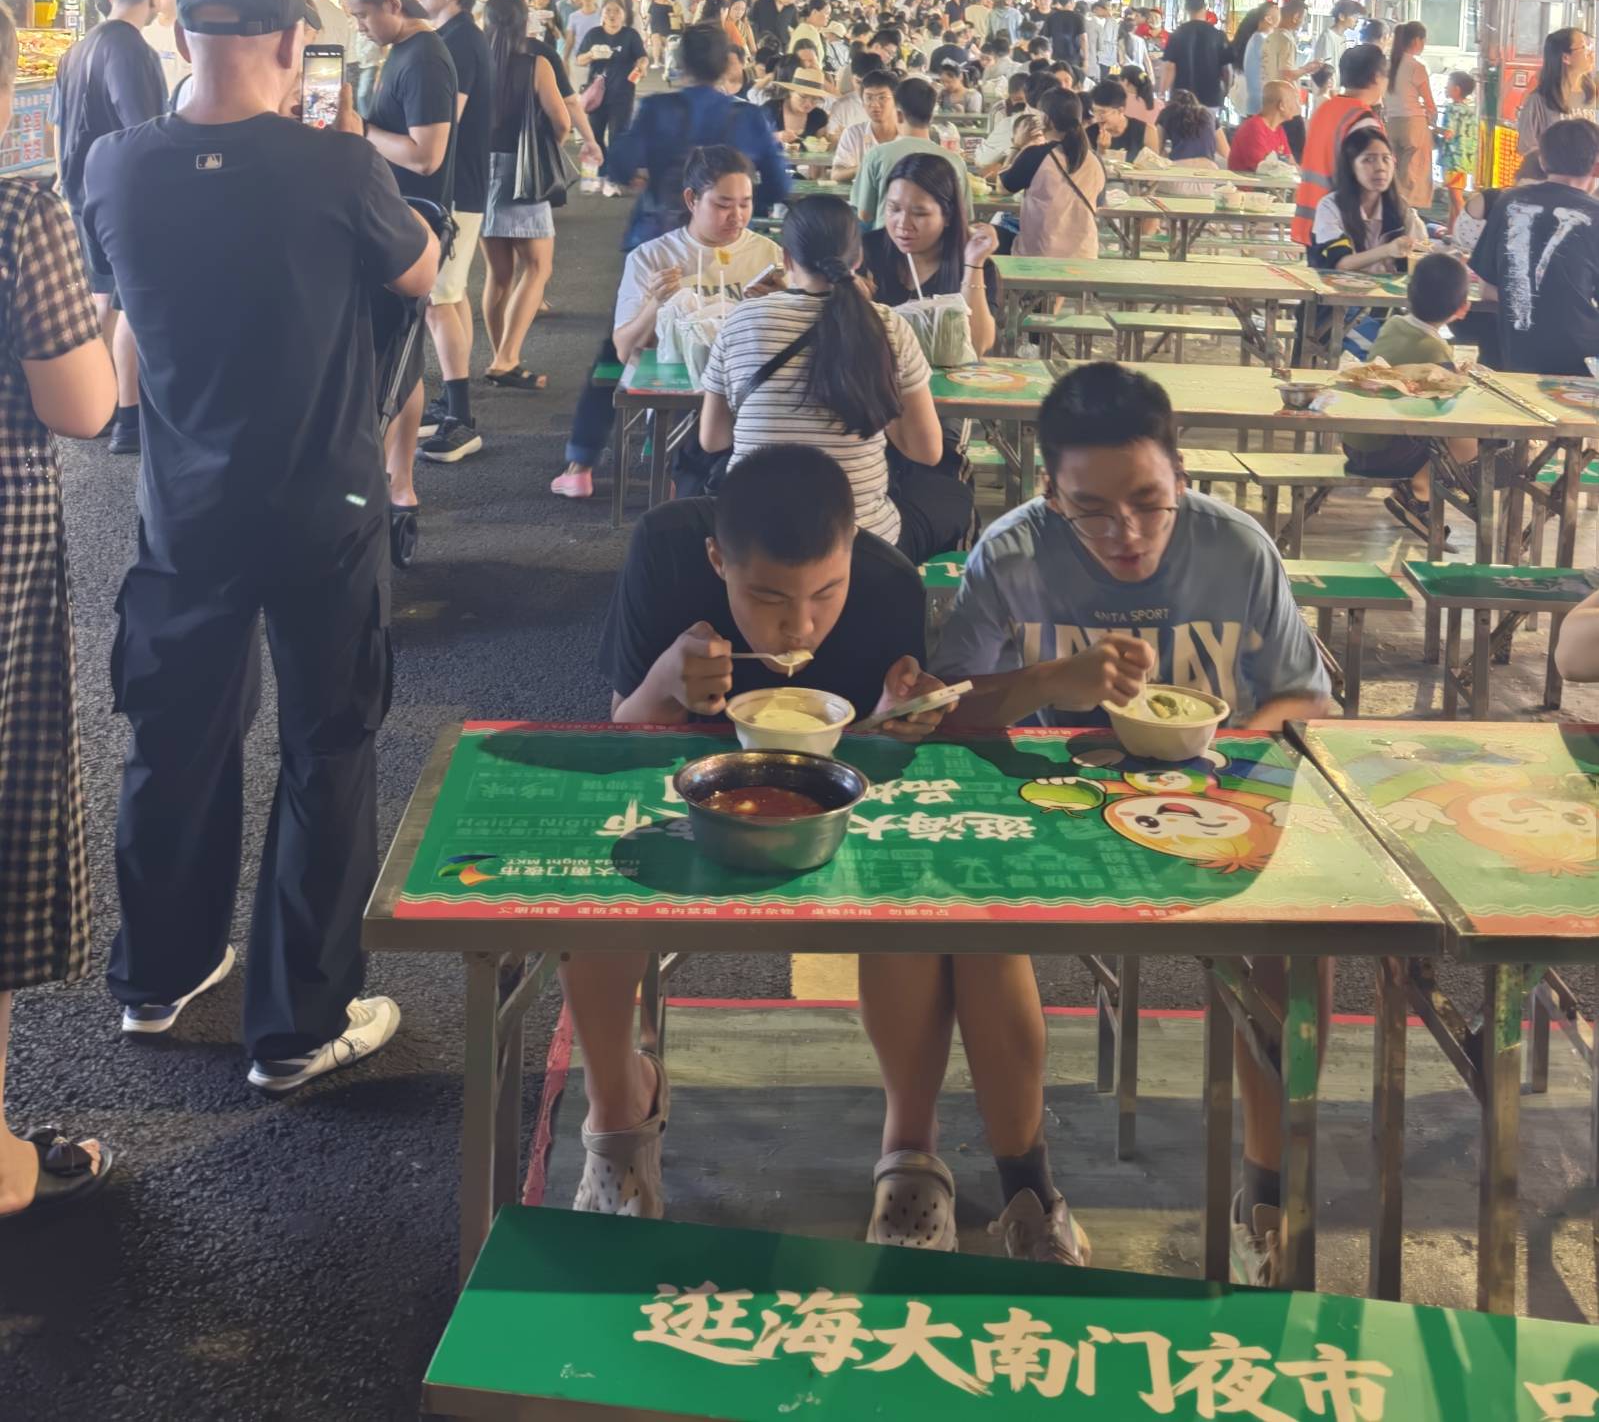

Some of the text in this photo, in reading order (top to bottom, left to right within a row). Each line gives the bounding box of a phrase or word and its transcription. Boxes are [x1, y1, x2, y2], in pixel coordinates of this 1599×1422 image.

[1130, 608, 1169, 621] SPORT
[546, 857, 591, 867] Night
[633, 1280, 1393, 1422] 逛海大南门夜市
